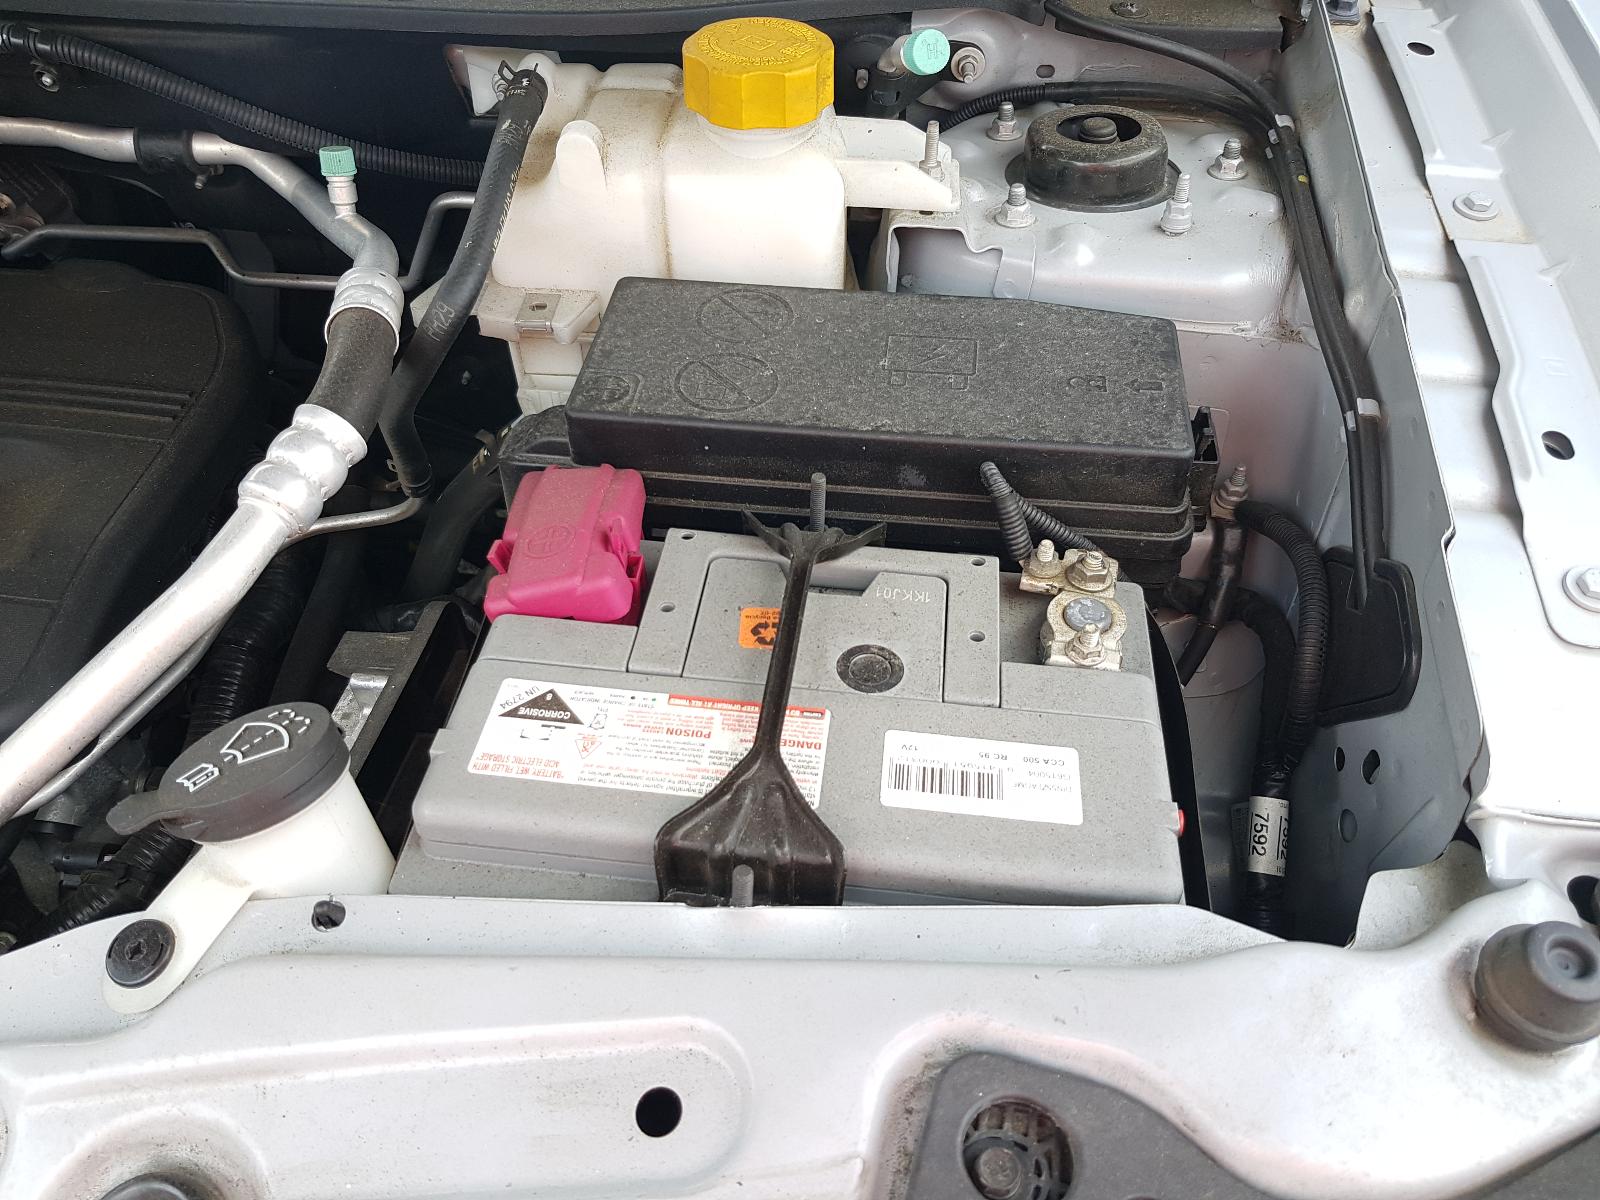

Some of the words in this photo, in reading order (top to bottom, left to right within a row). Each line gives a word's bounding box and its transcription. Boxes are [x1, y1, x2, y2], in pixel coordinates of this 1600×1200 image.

[875, 586, 931, 604] 1KKJ01
[524, 685, 541, 697] UN
[499, 693, 523, 711] 2794
[545, 692, 553, 702] 8
[517, 706, 571, 720] CORROSIVE
[665, 727, 712, 739] POISON
[780, 738, 823, 751] DANGE
[900, 743, 919, 752] 12V
[977, 751, 990, 760] 95
[992, 752, 1009, 762] RC
[1021, 756, 1040, 765] 500
[472, 762, 490, 772] WITH
[511, 756, 544, 767] ELECTRIC
[543, 758, 561, 769] ACID
[1042, 758, 1066, 767] CCA
[491, 763, 514, 774] FILLED
[1251, 812, 1270, 857] 7592
